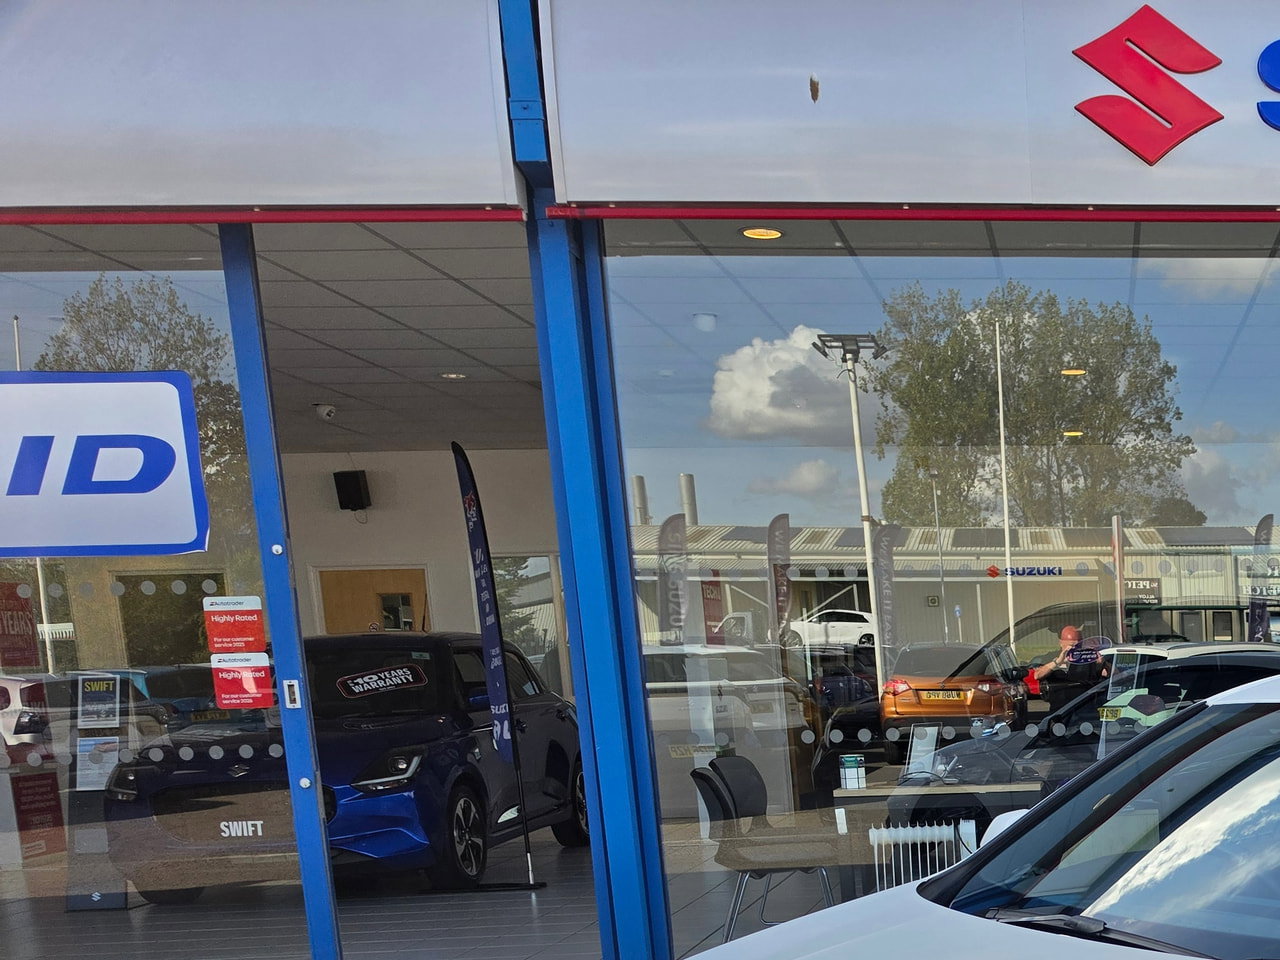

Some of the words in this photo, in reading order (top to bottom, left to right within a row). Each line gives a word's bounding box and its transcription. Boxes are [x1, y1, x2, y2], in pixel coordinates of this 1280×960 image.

[6, 435, 176, 496] ID
[1004, 567, 1062, 576] SUZUKI
[211, 614, 234, 623] Highly
[219, 672, 241, 680] Highly
[242, 670, 265, 678] Rated
[353, 674, 379, 684] 10
[378, 668, 411, 679] YEARS
[84, 681, 114, 692] SWIFT
[351, 675, 414, 693] WARRANTY
[220, 821, 263, 837] SWIFT
